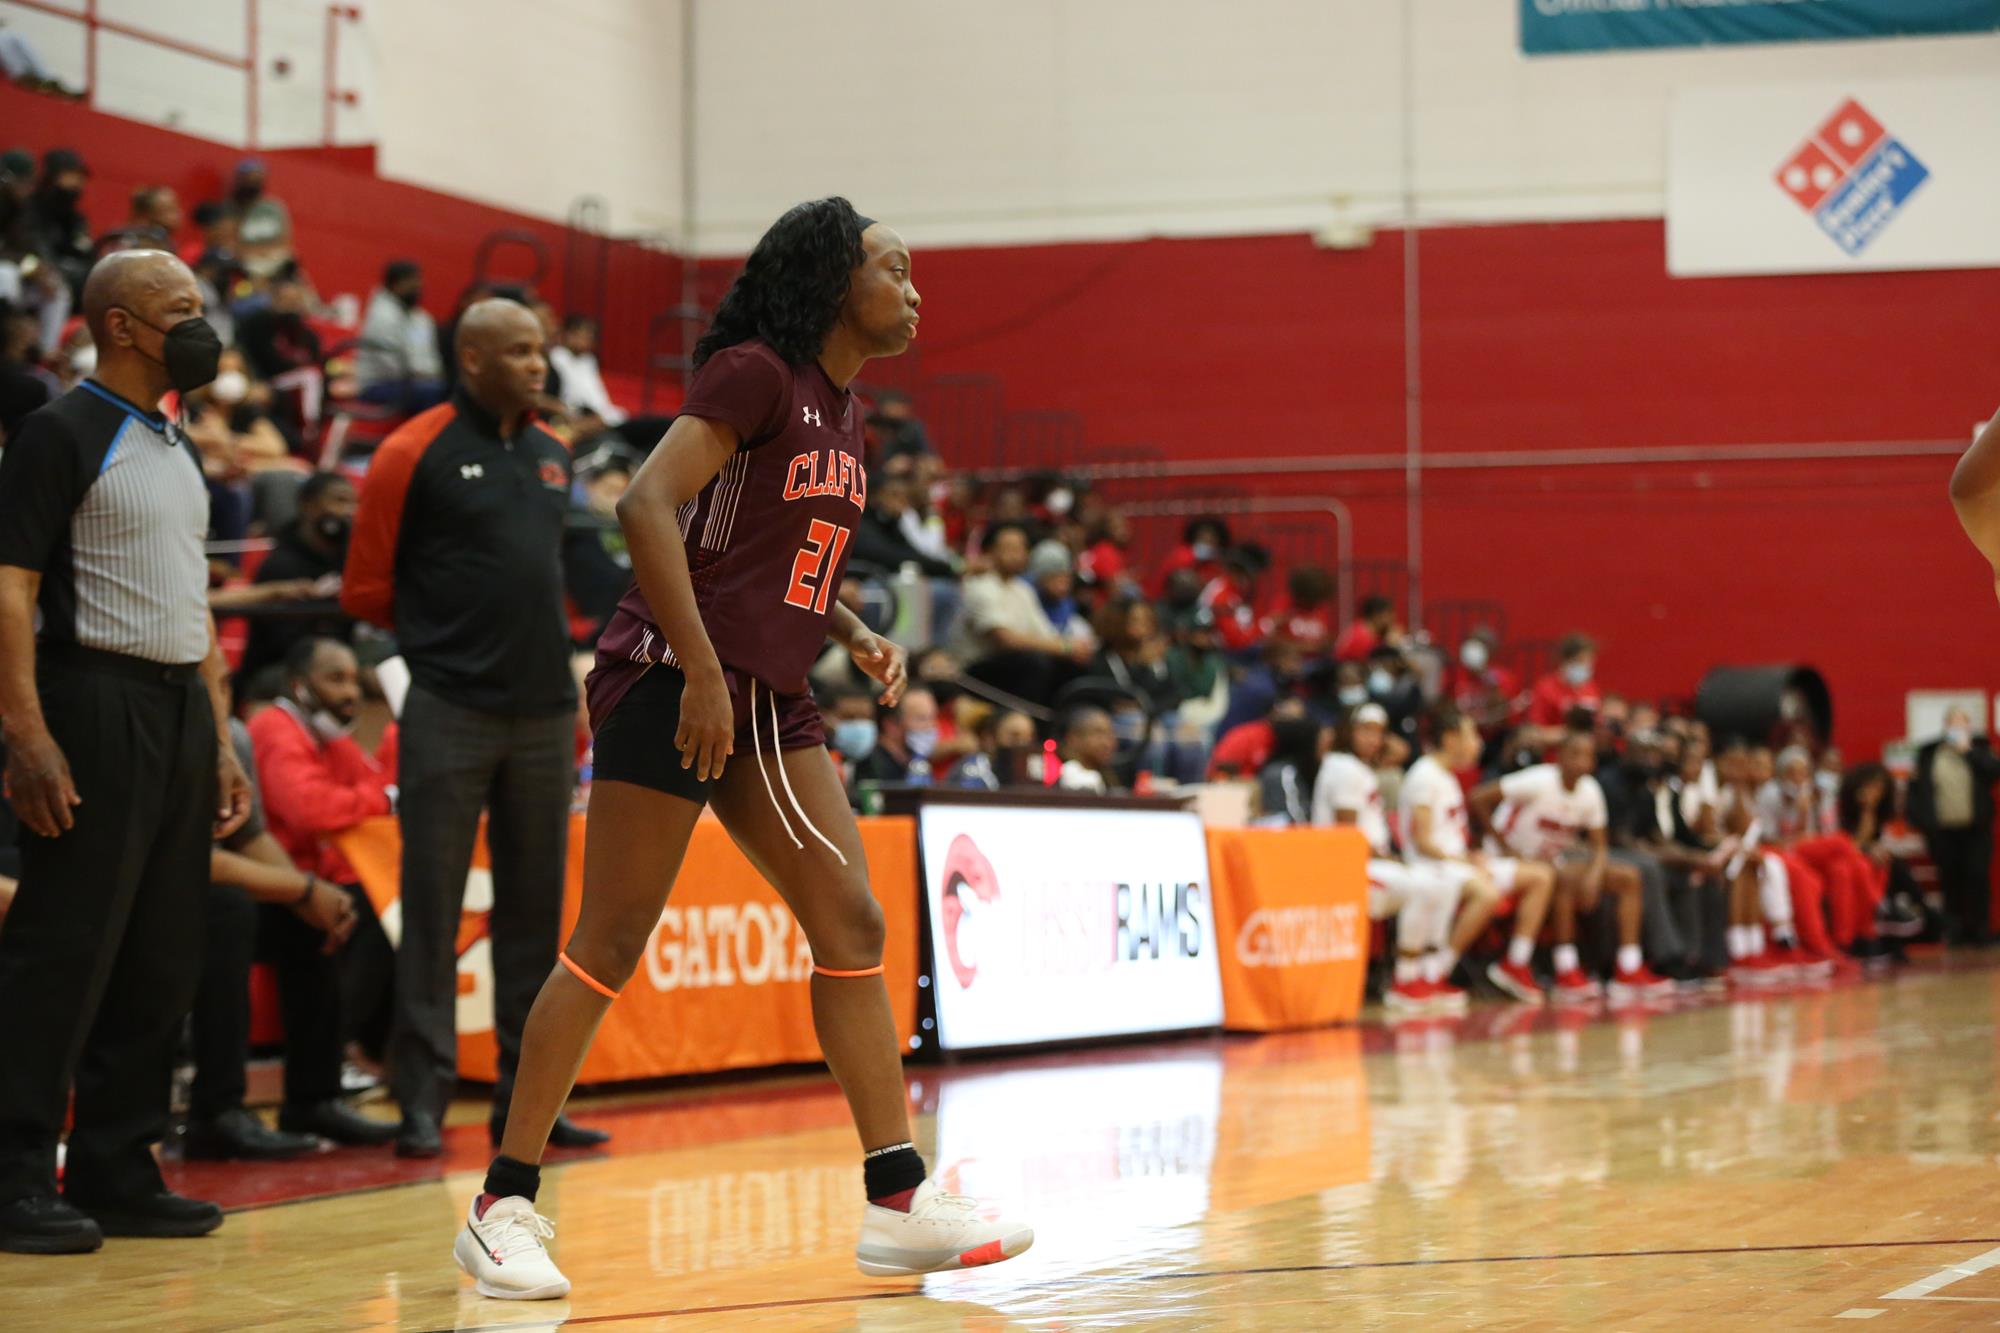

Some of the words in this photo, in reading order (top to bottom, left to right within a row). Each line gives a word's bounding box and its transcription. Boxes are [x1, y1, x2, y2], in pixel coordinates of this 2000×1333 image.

[783, 449, 867, 512] CLAFL
[784, 518, 850, 615] 21
[645, 901, 815, 992] GATORA
